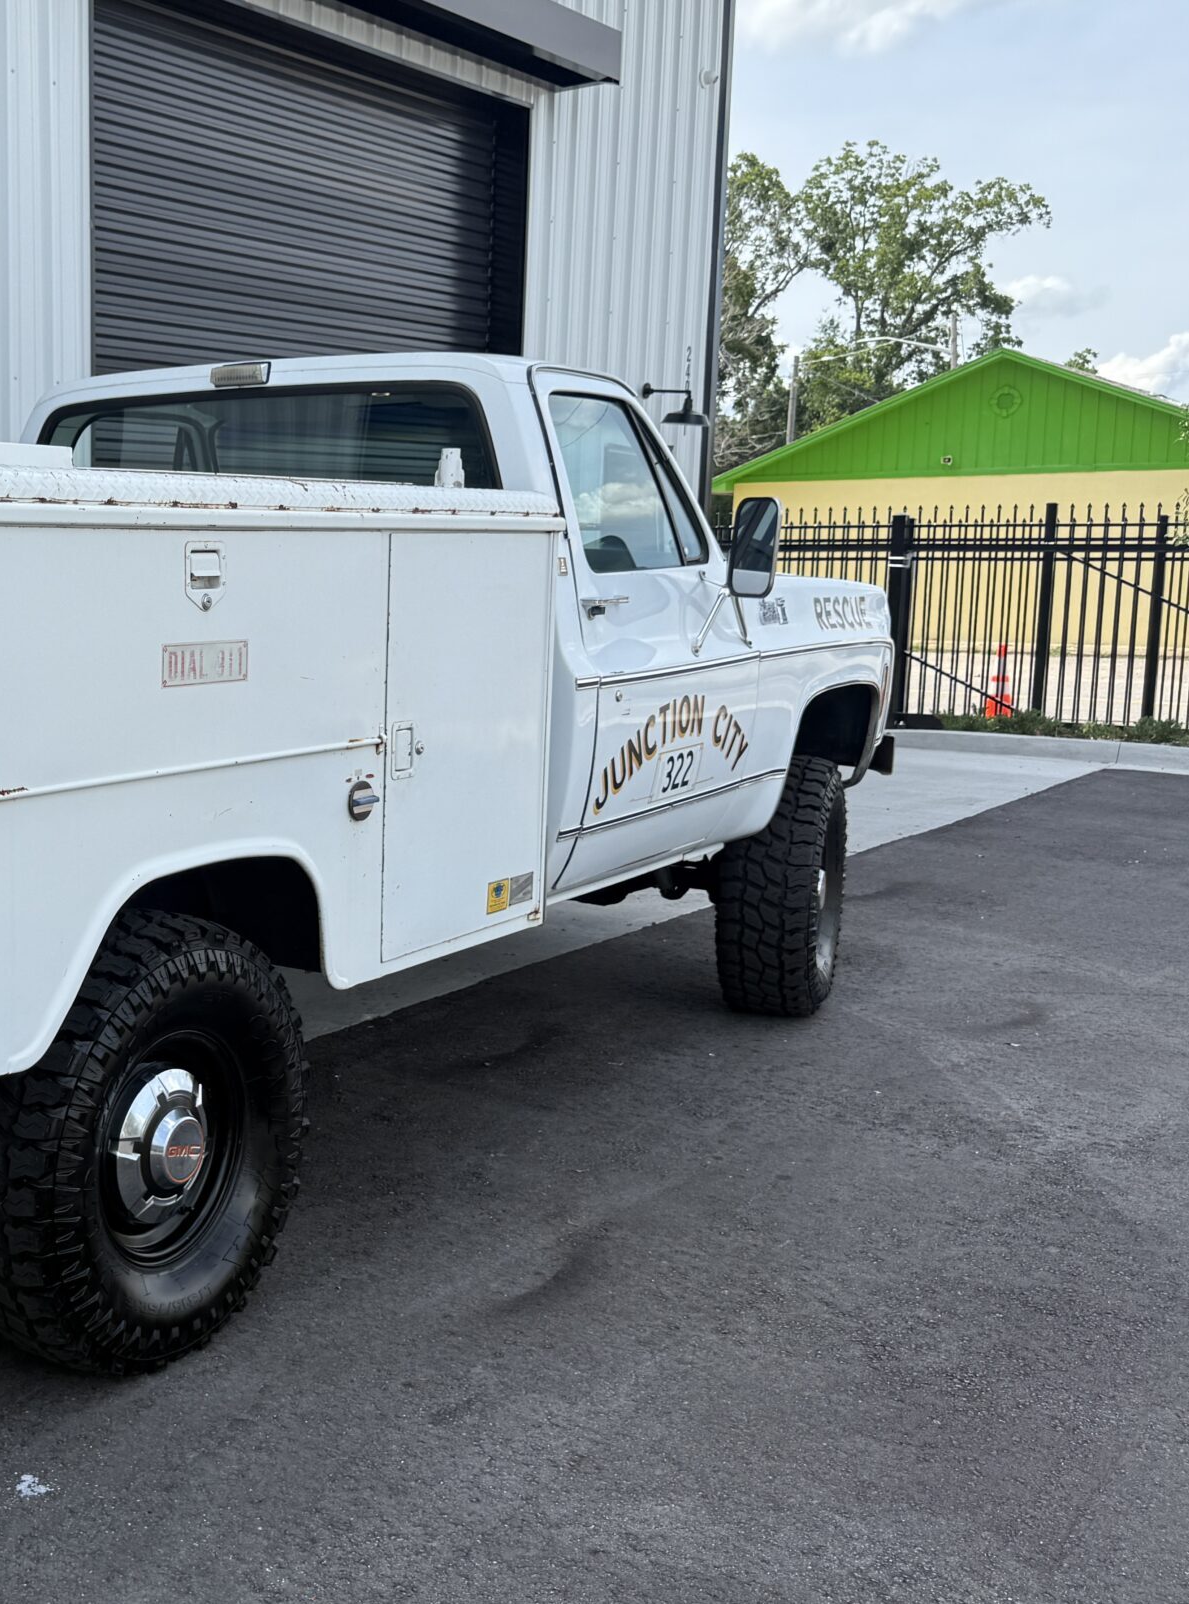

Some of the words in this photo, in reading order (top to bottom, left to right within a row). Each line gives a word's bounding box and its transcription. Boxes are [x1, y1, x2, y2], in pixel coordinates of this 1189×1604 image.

[813, 596, 873, 631] RESCUE
[168, 650, 208, 681] DIAL
[593, 694, 706, 816] JUNCTION
[712, 704, 749, 772] CITY
[662, 750, 694, 793] 322
[167, 1146, 201, 1158] GMC
